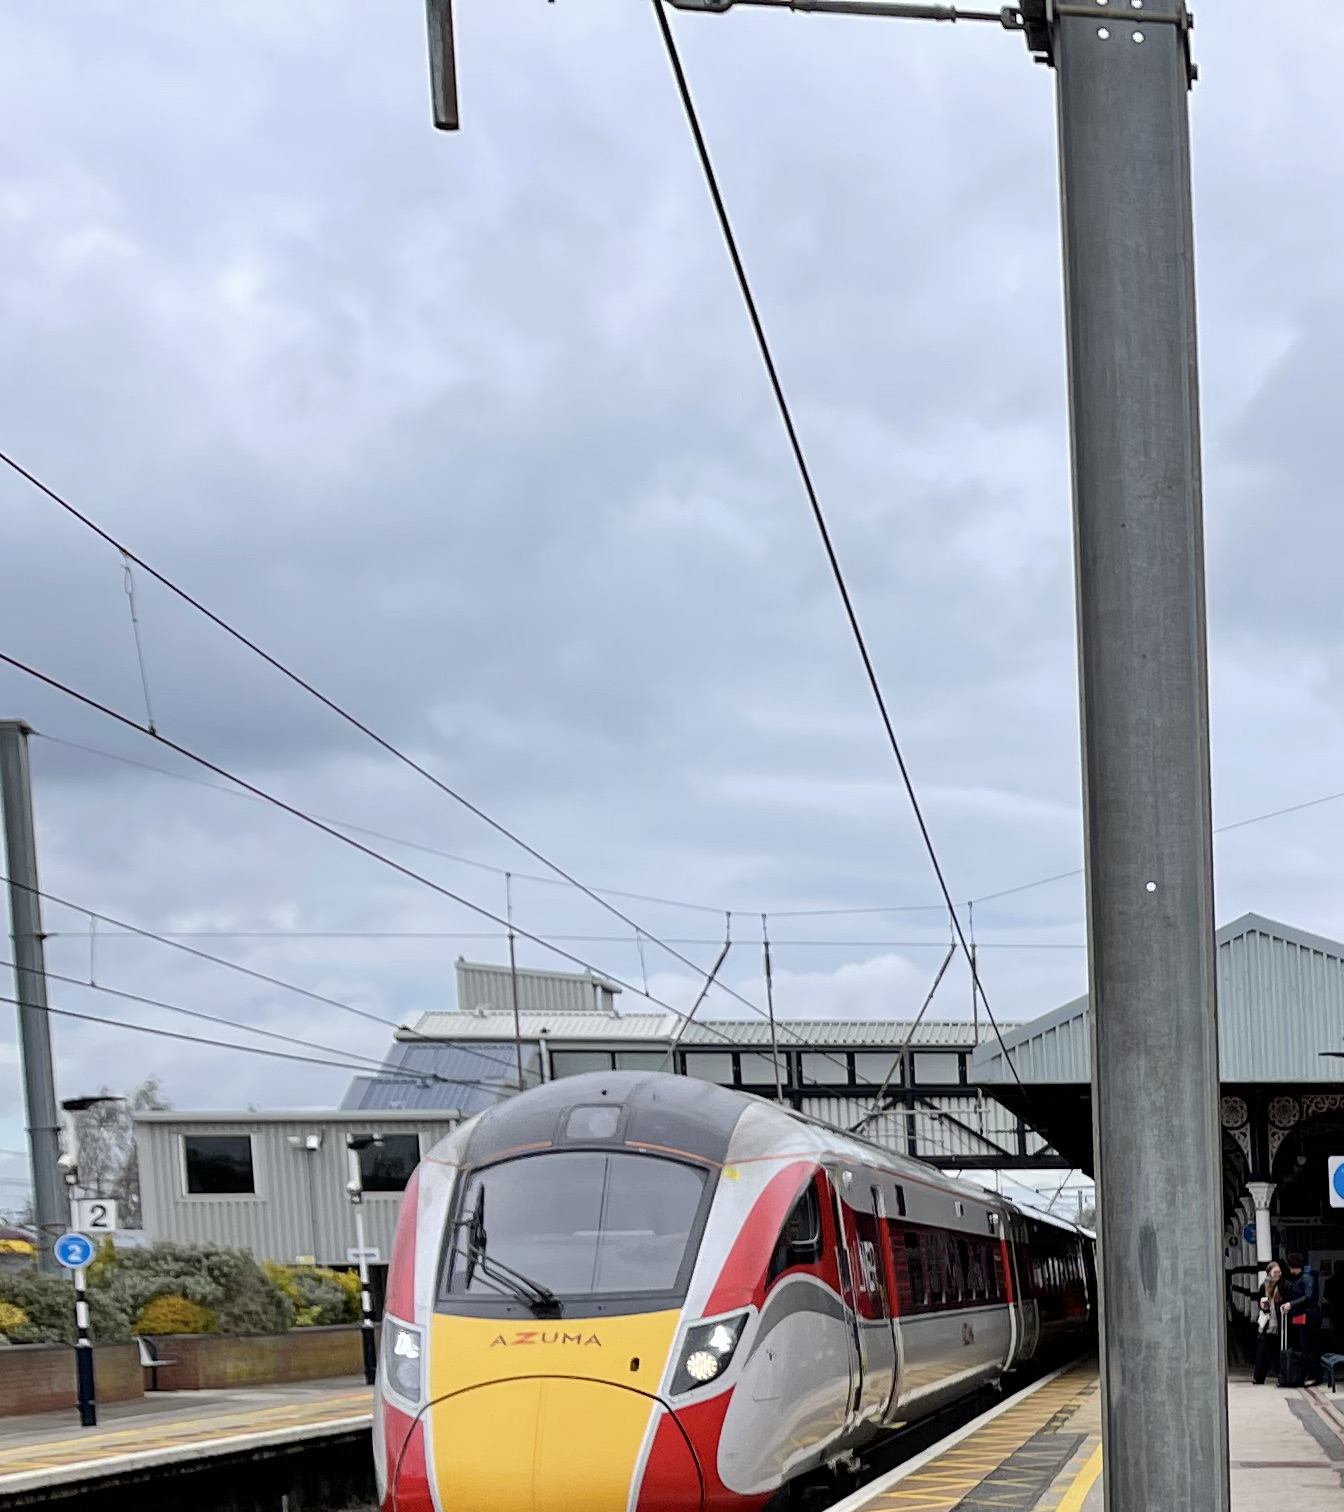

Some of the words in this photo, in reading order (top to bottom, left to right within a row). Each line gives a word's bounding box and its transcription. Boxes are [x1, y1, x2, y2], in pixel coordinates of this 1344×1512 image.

[90, 1204, 107, 1228] 2
[67, 1244, 83, 1262] 2
[489, 1331, 602, 1347] AZUMA
